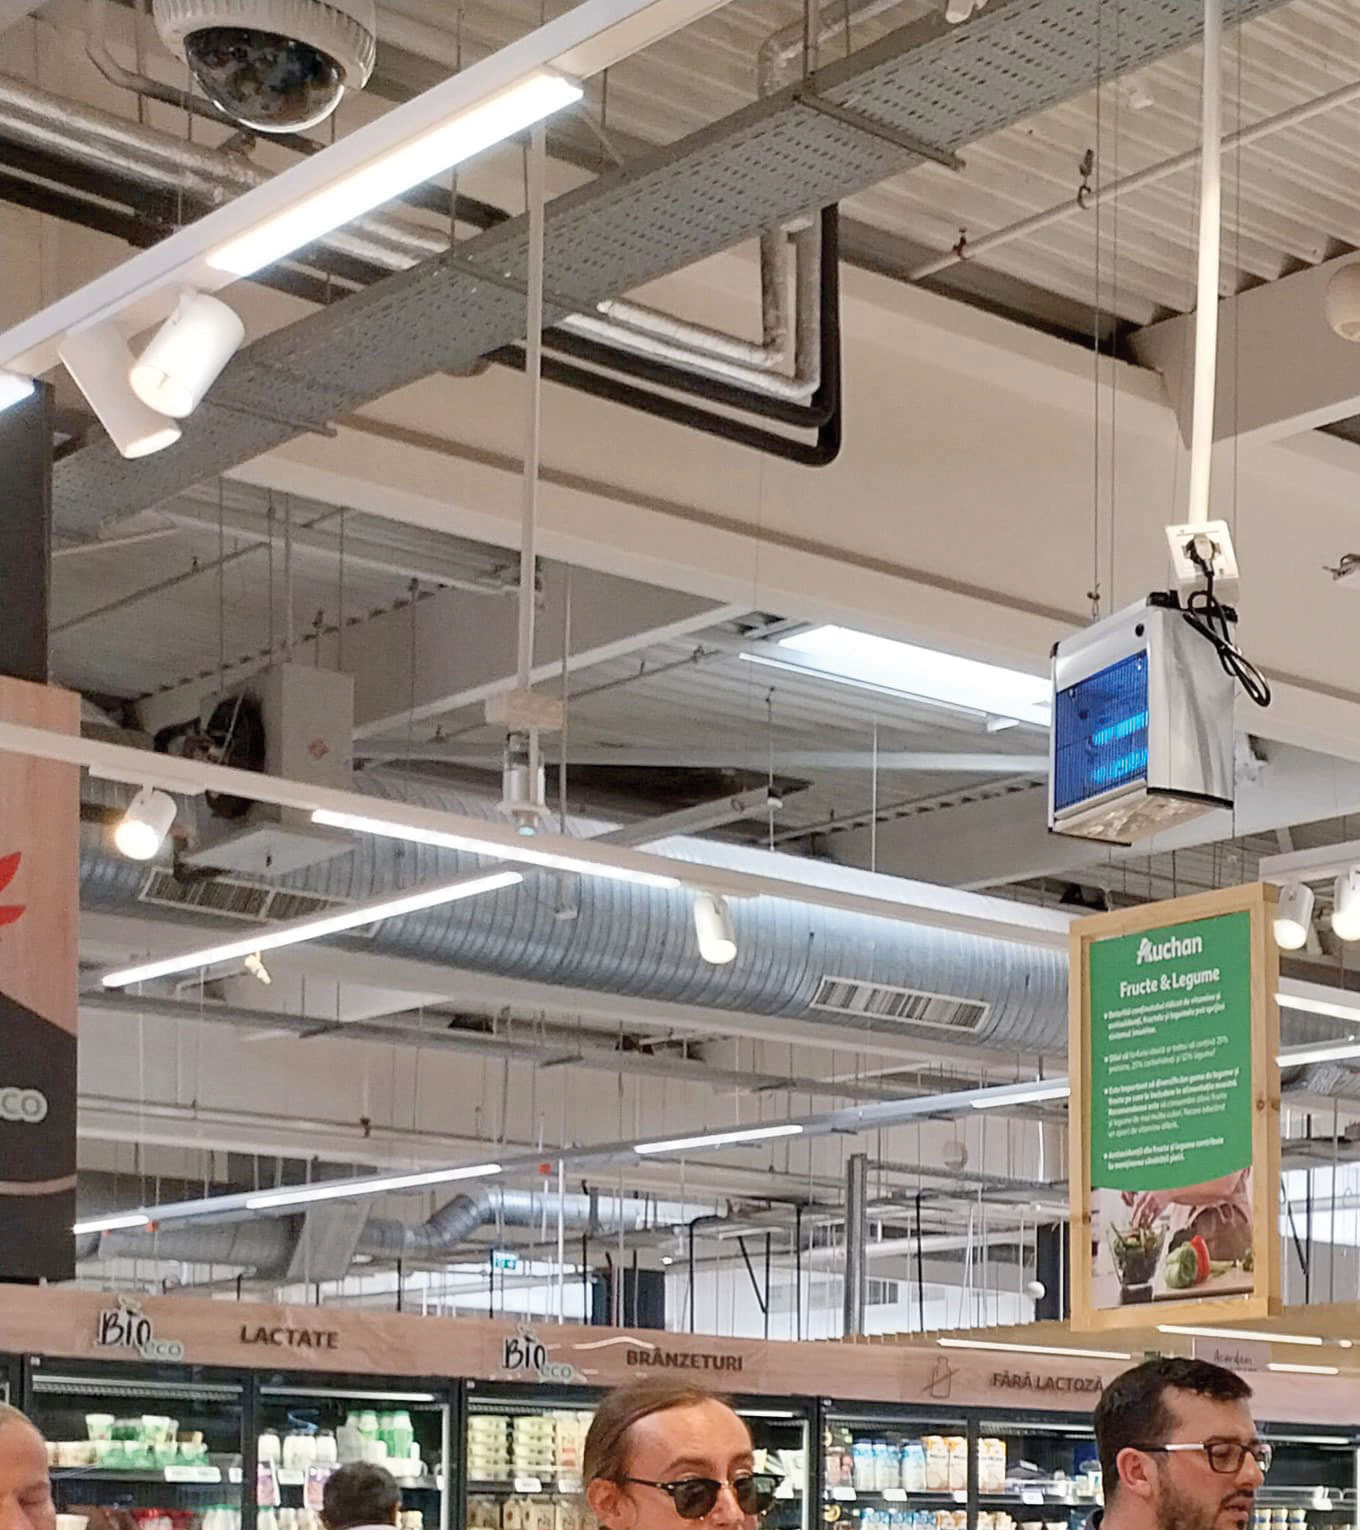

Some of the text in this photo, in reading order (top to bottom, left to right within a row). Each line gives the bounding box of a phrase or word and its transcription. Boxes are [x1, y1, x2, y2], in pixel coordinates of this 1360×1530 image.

[1136, 935, 1202, 965] Auchan
[1119, 966, 1221, 999] Fructe & Legume
[240, 1324, 339, 1349] LACTATE
[626, 1347, 744, 1371] BRÂNZETURI
